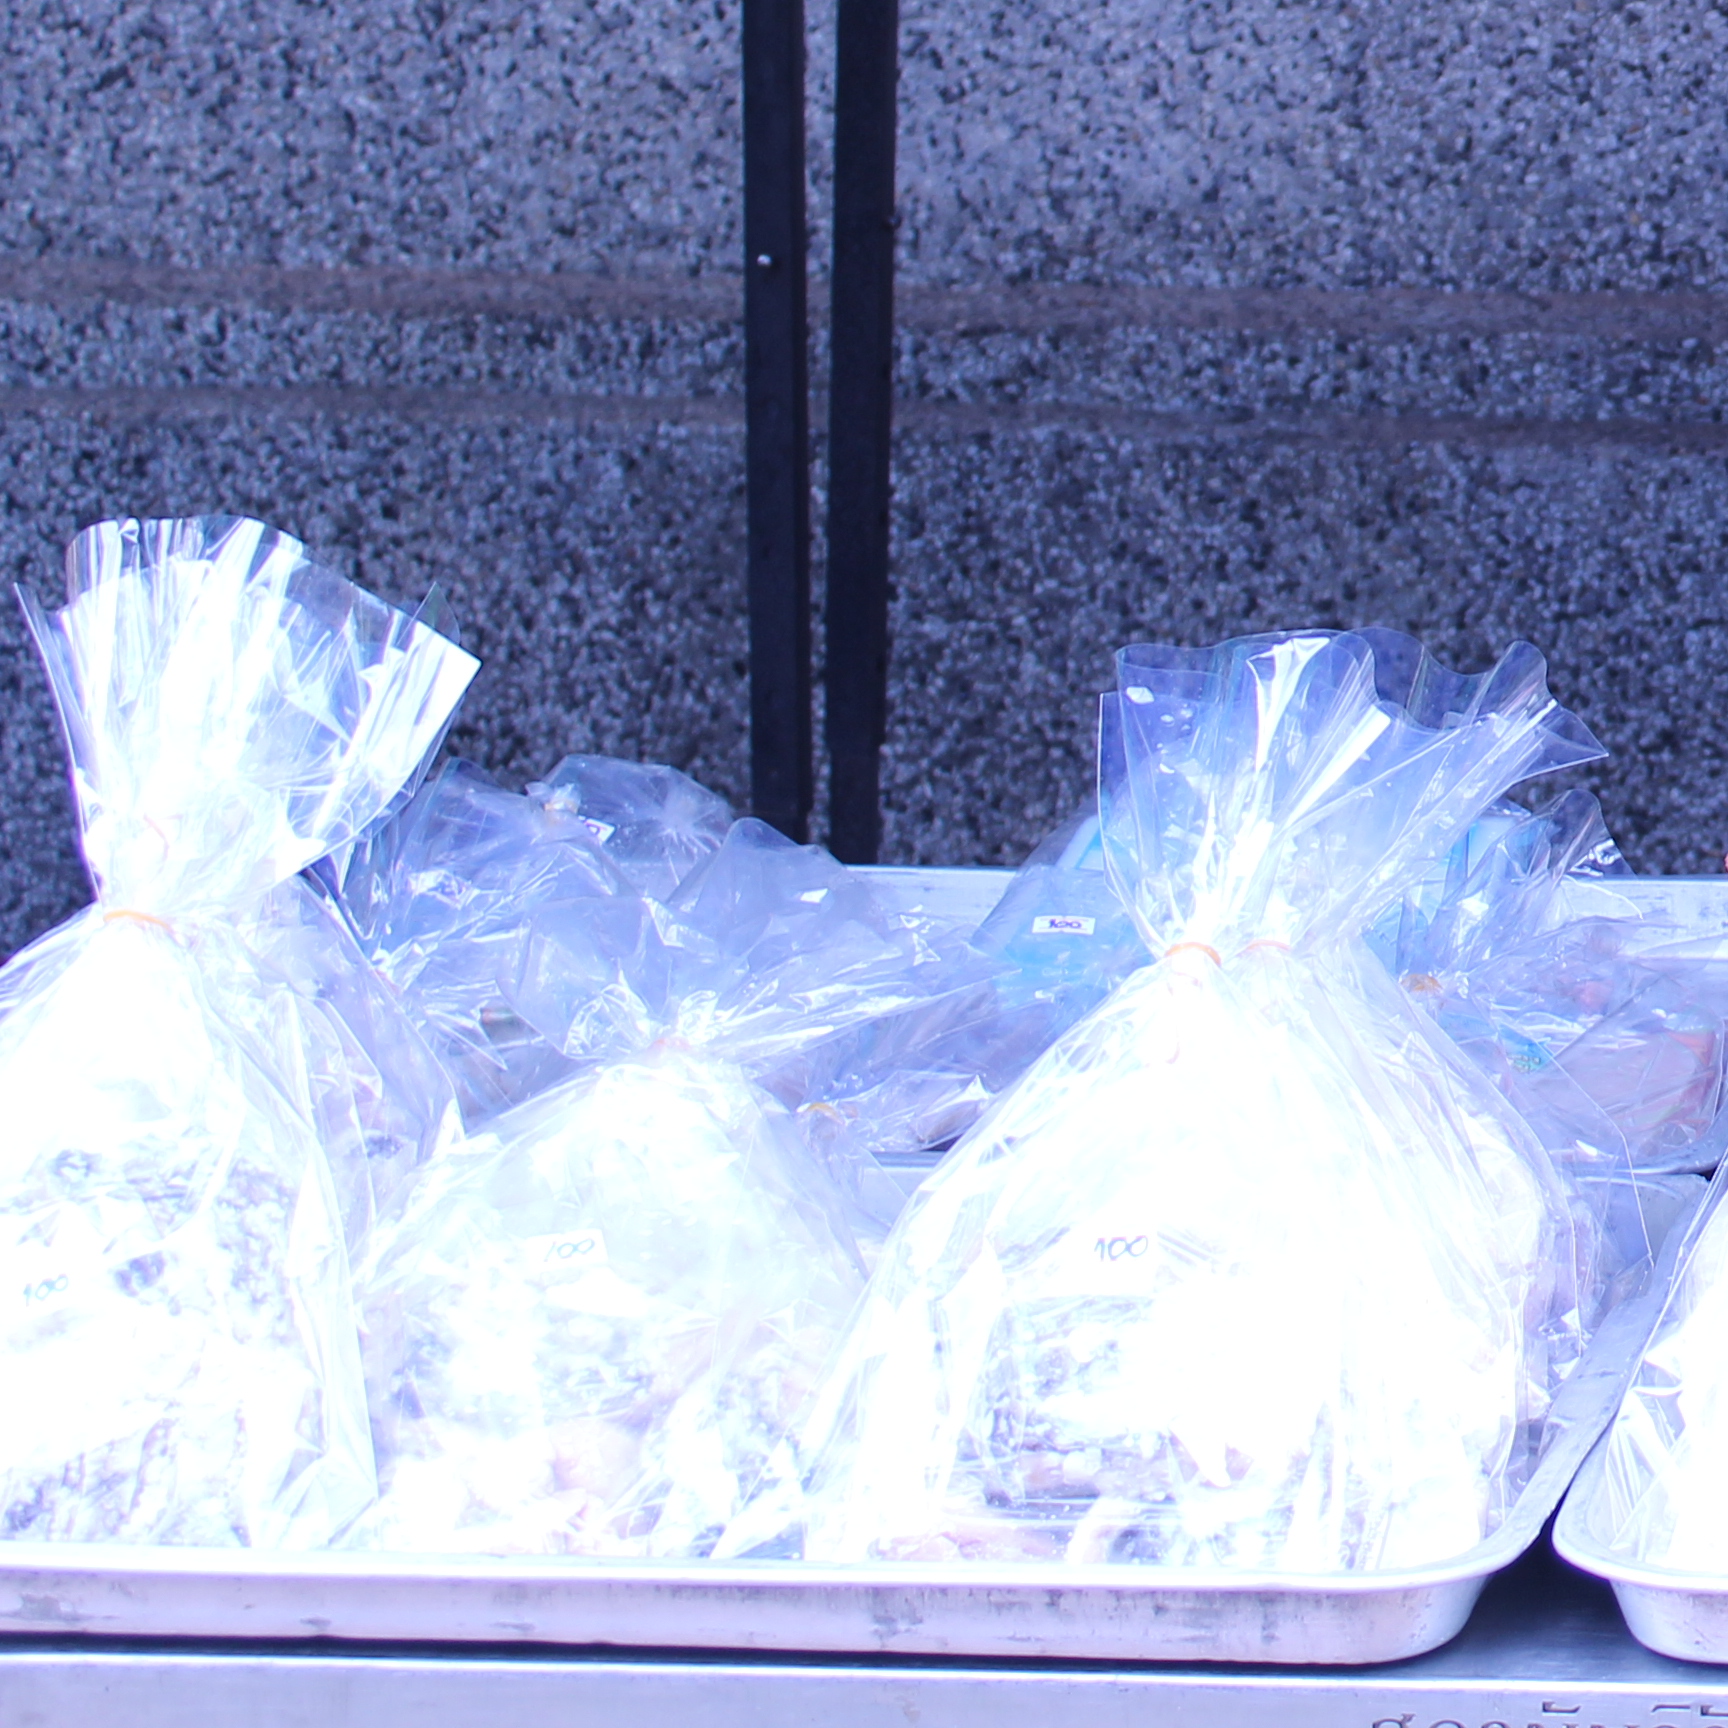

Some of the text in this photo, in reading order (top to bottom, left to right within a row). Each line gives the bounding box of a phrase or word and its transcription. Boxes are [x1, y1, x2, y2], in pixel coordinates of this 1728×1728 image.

[545, 1238, 595, 1263] 100
[1095, 1236, 1148, 1261] 100
[23, 1274, 68, 1306] 100
